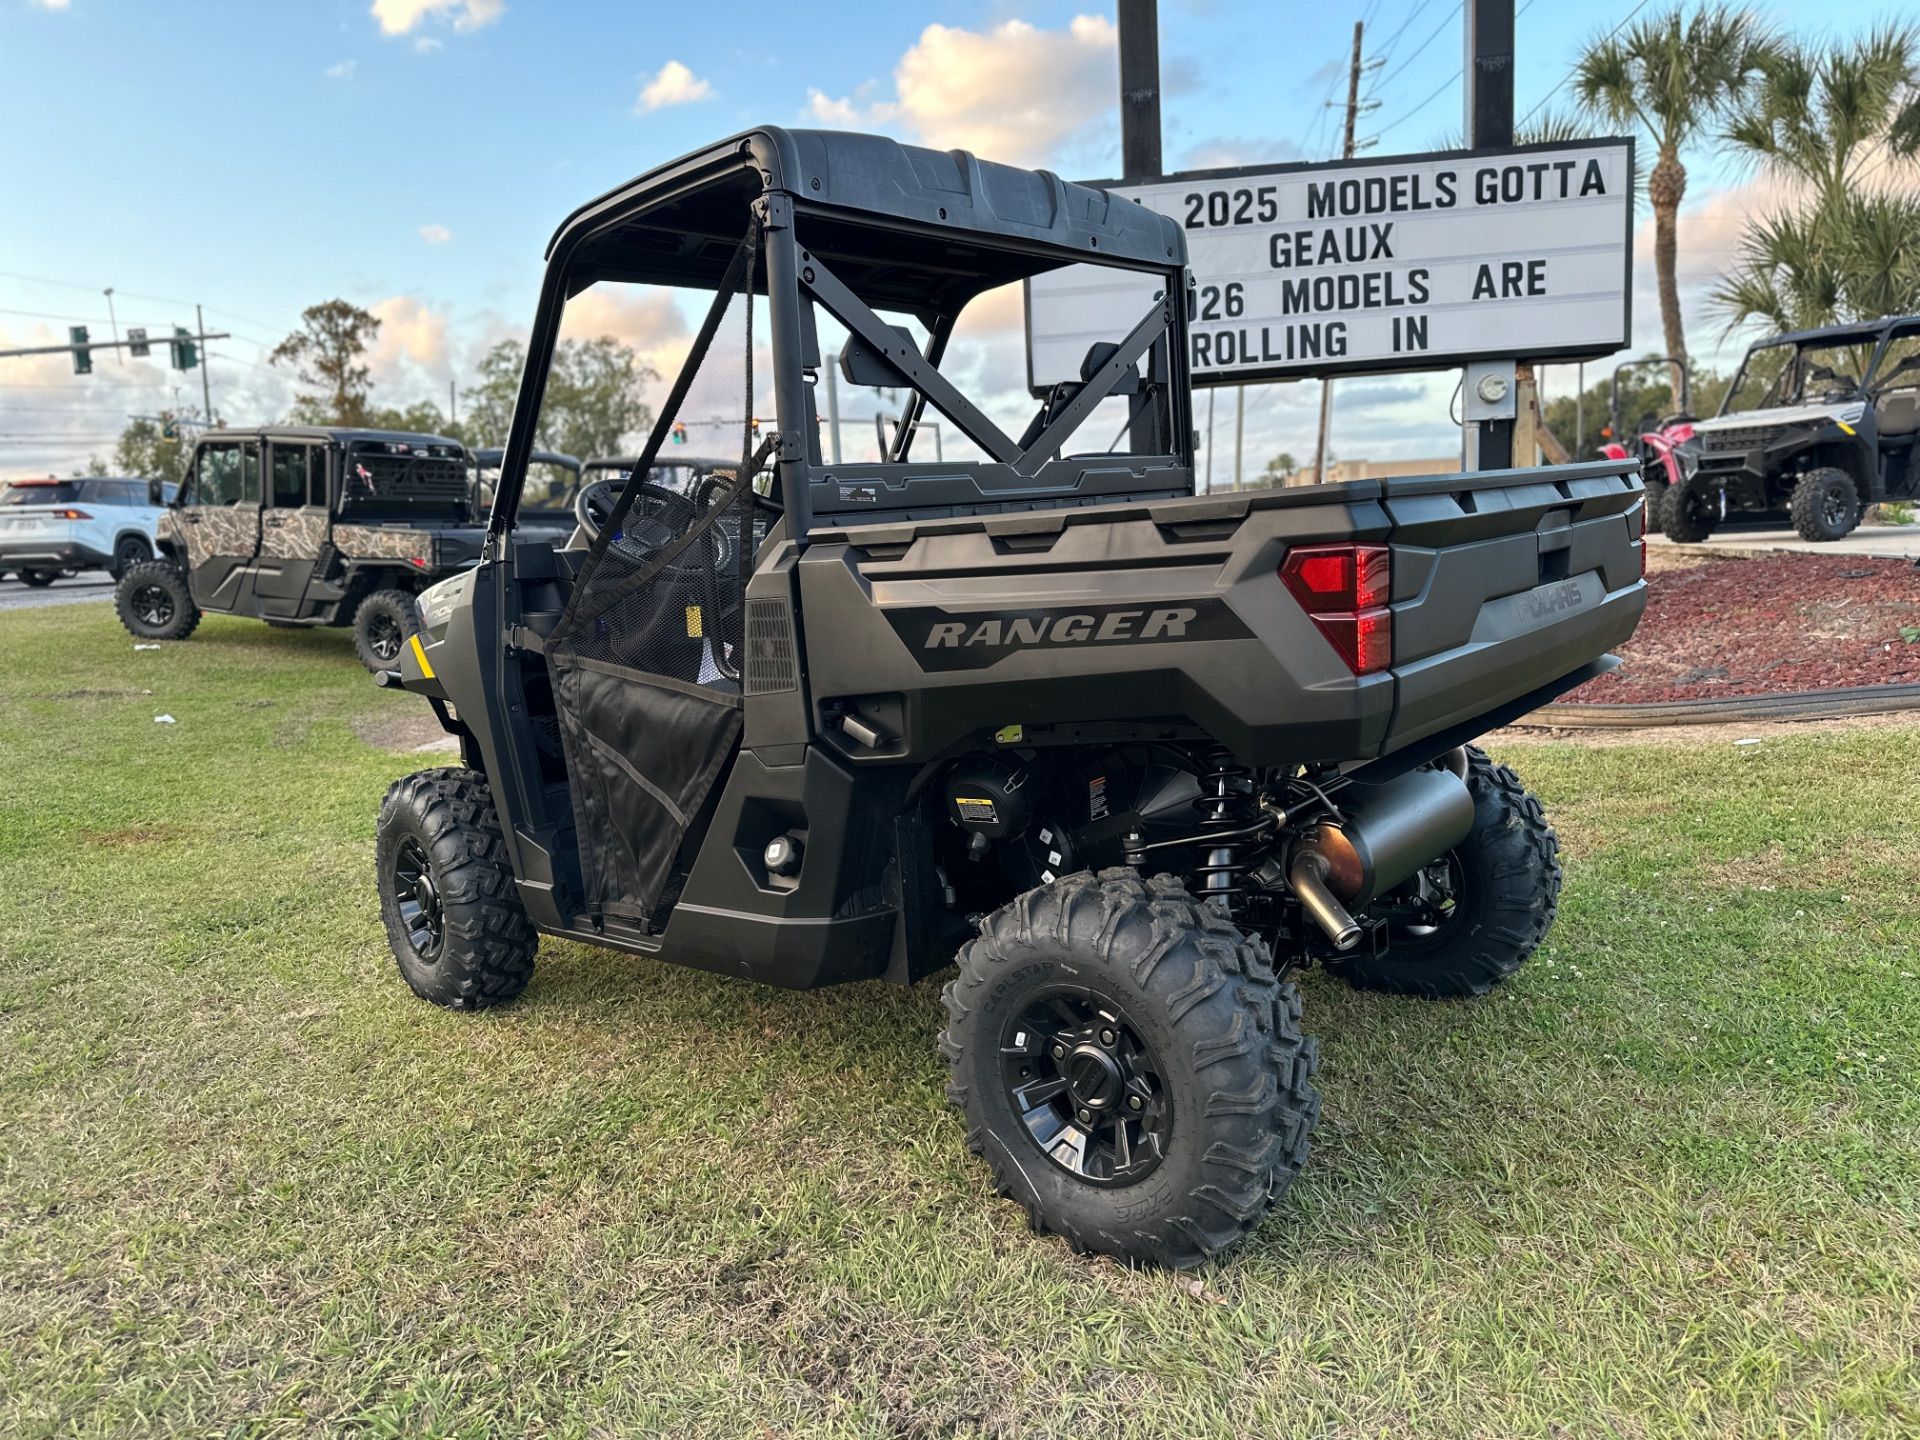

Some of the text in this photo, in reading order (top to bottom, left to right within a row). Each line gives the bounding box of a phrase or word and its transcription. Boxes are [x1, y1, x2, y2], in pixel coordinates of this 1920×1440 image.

[1184, 159, 1606, 229] 2025 MODELS GOTTA
[1270, 222, 1394, 268] GEAUX
[1153, 260, 1546, 321] 26 MODELS ARE
[1191, 315, 1428, 367] ROLLING IN
[924, 607, 1197, 649] RANGER
